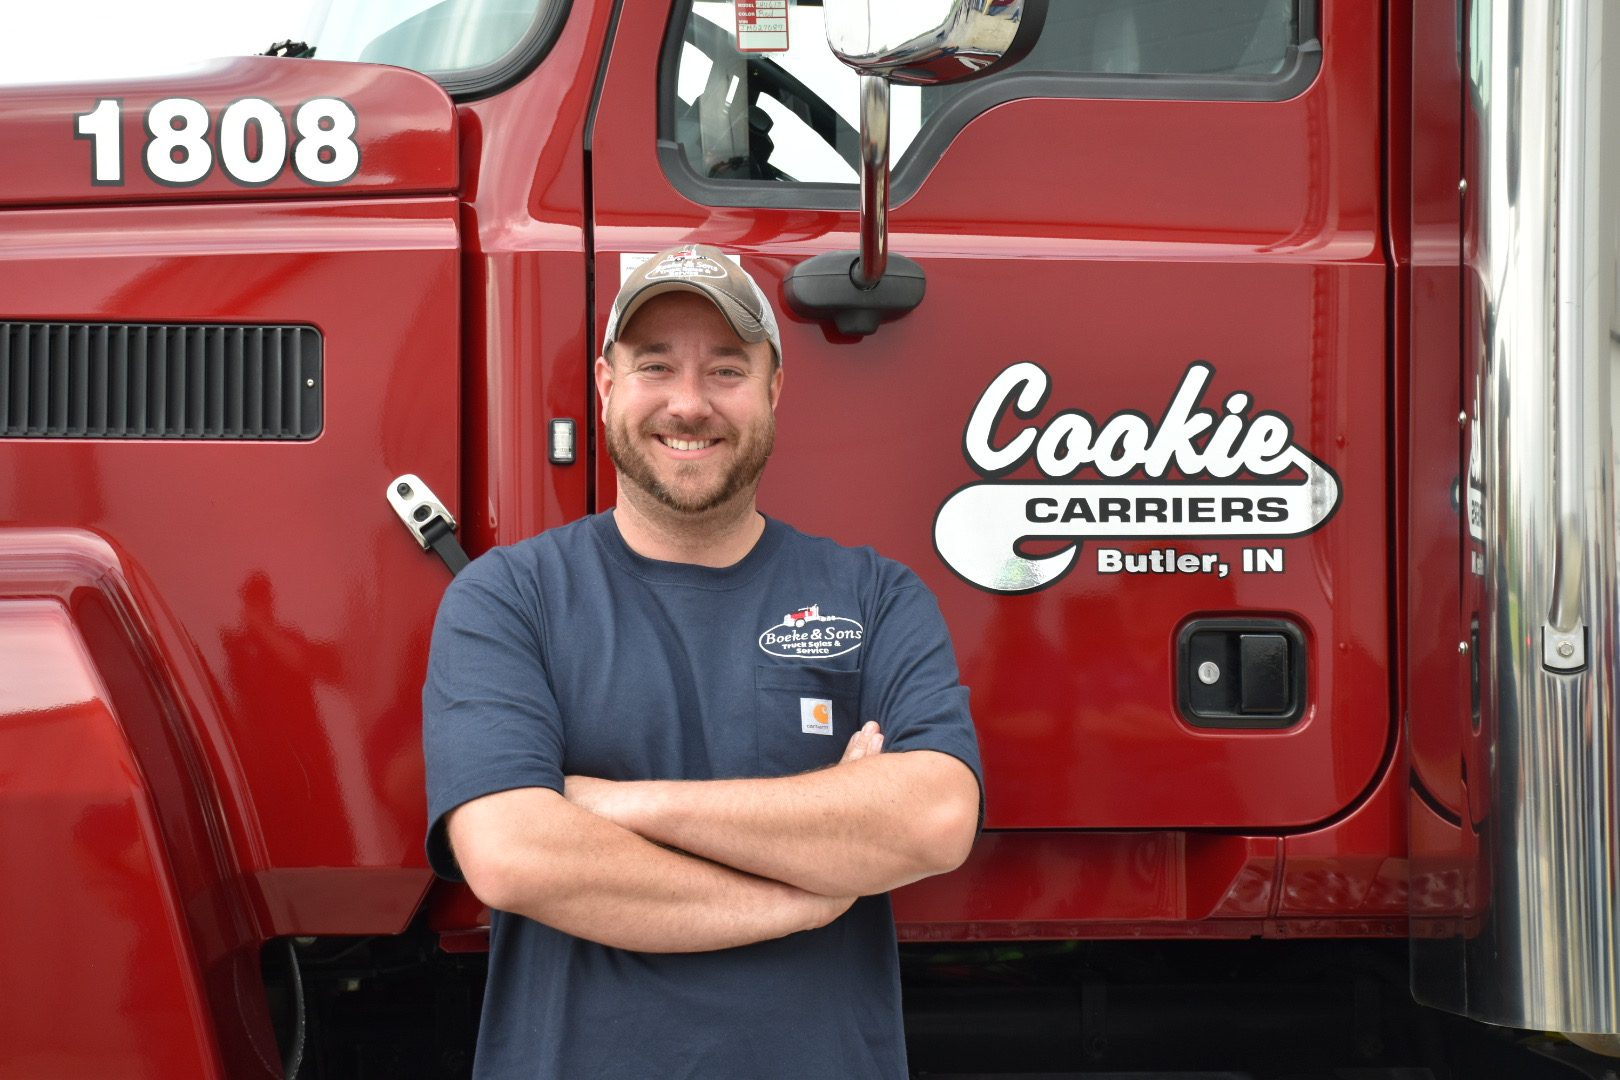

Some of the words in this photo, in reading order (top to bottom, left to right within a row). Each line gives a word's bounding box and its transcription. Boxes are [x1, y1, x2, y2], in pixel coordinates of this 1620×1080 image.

[75, 97, 361, 185] 1808
[964, 360, 1294, 477] Cookie
[1025, 497, 1289, 523] CARRIERS
[1097, 548, 1228, 577] Butler,
[1242, 548, 1284, 573] IN
[765, 629, 808, 645] Boeke
[811, 628, 822, 640] &
[824, 626, 863, 640] Sons
[782, 641, 807, 649] Truck
[808, 640, 832, 649] Sales
